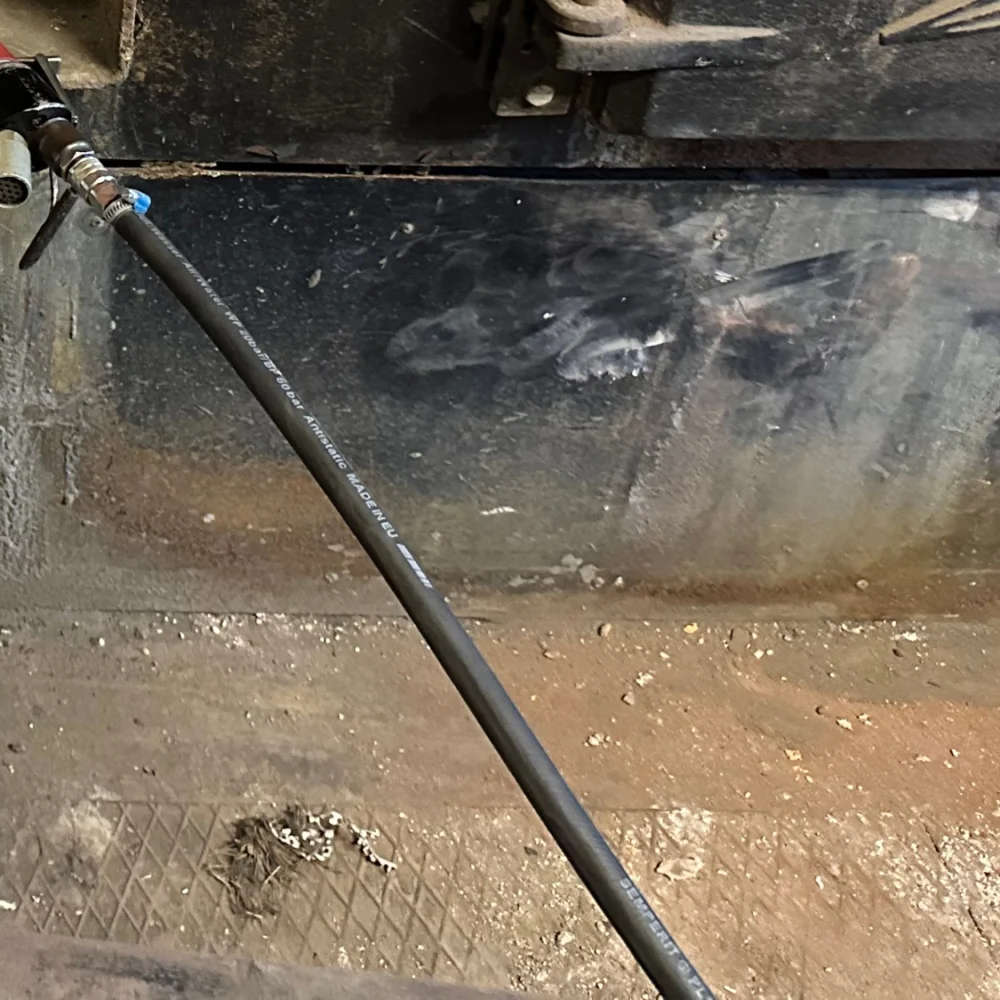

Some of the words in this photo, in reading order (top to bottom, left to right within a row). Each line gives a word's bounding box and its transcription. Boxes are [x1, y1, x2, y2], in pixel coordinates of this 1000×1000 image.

[303, 414, 347, 470] Antistatic
[346, 473, 377, 509] MADE
[371, 508, 387, 522] IN
[380, 521, 399, 539] EU
[620, 879, 679, 955] SEMPERIT
